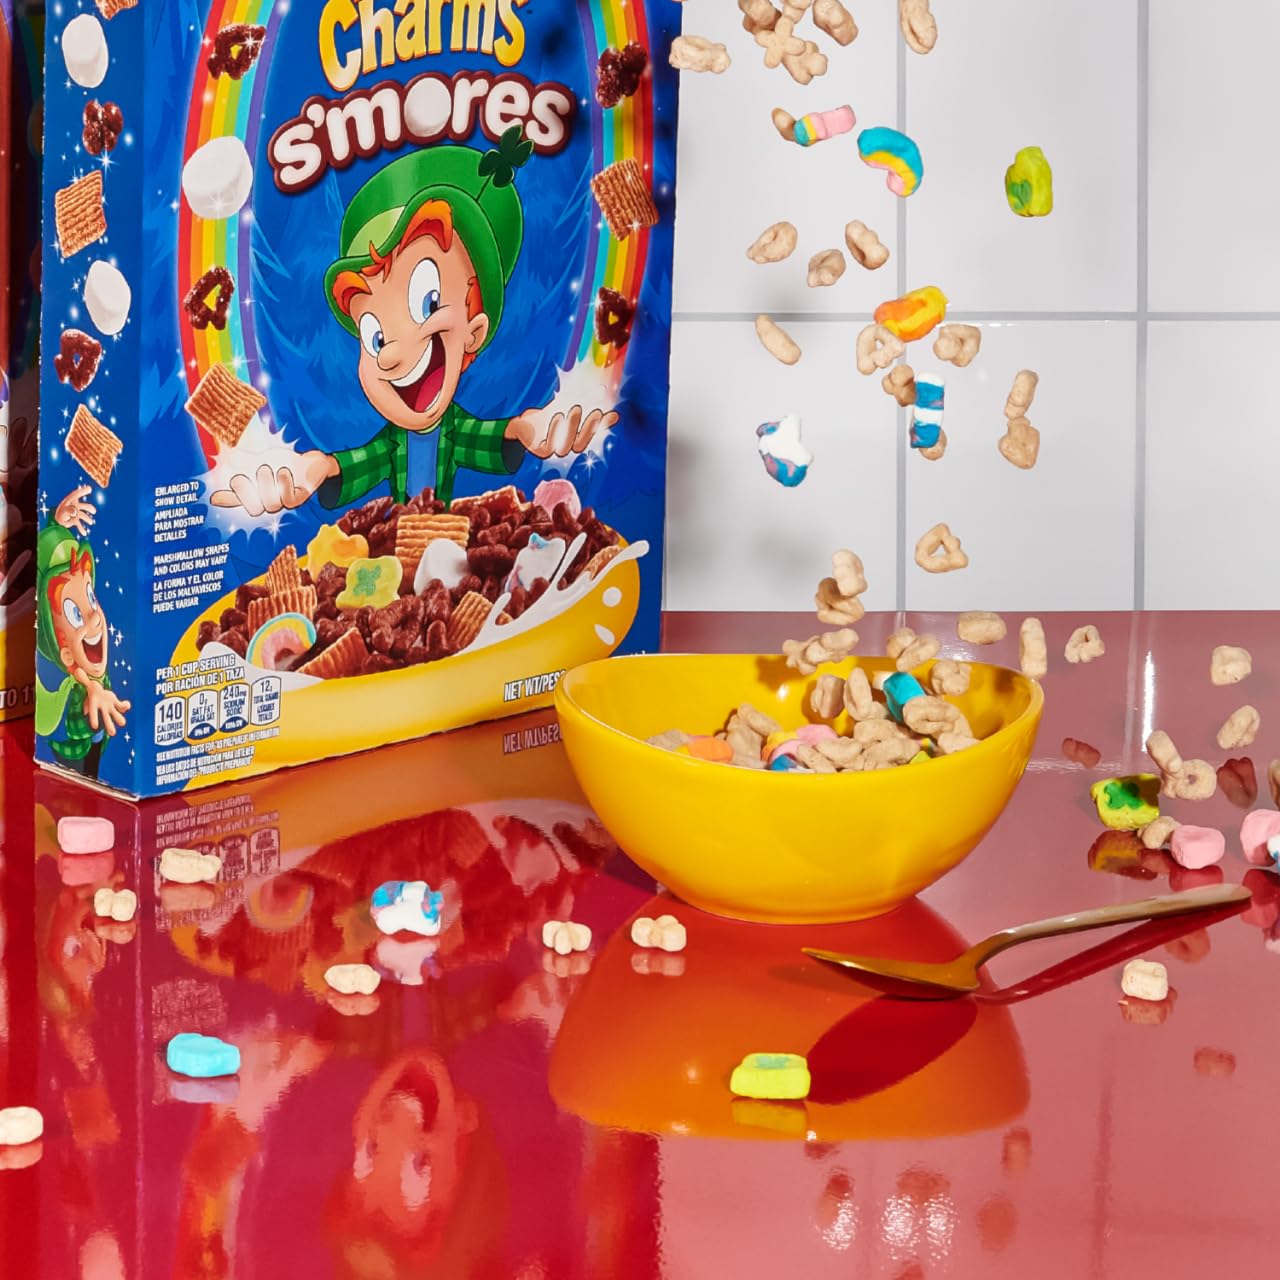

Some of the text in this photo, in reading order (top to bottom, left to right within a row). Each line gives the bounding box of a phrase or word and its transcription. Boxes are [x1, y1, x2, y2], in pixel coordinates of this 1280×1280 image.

[272, 75, 570, 187] s'mores
[155, 482, 198, 496] ENLARGED TO
[155, 493, 198, 507] SHOW DETAIL
[155, 507, 188, 521] AMPLIADA
[155, 516, 203, 532] PARA MOSTRAR
[155, 529, 186, 542] DETALLES
[154, 544, 229, 564] MARSHMALLOW SHAPES
[156, 654, 235, 680] PER 1 CUP SERVING
[156, 667, 244, 695] POR RACIÓN DE 1 TAZA
[504, 669, 565, 701] NET WT/PES
[159, 702, 182, 720] 140
